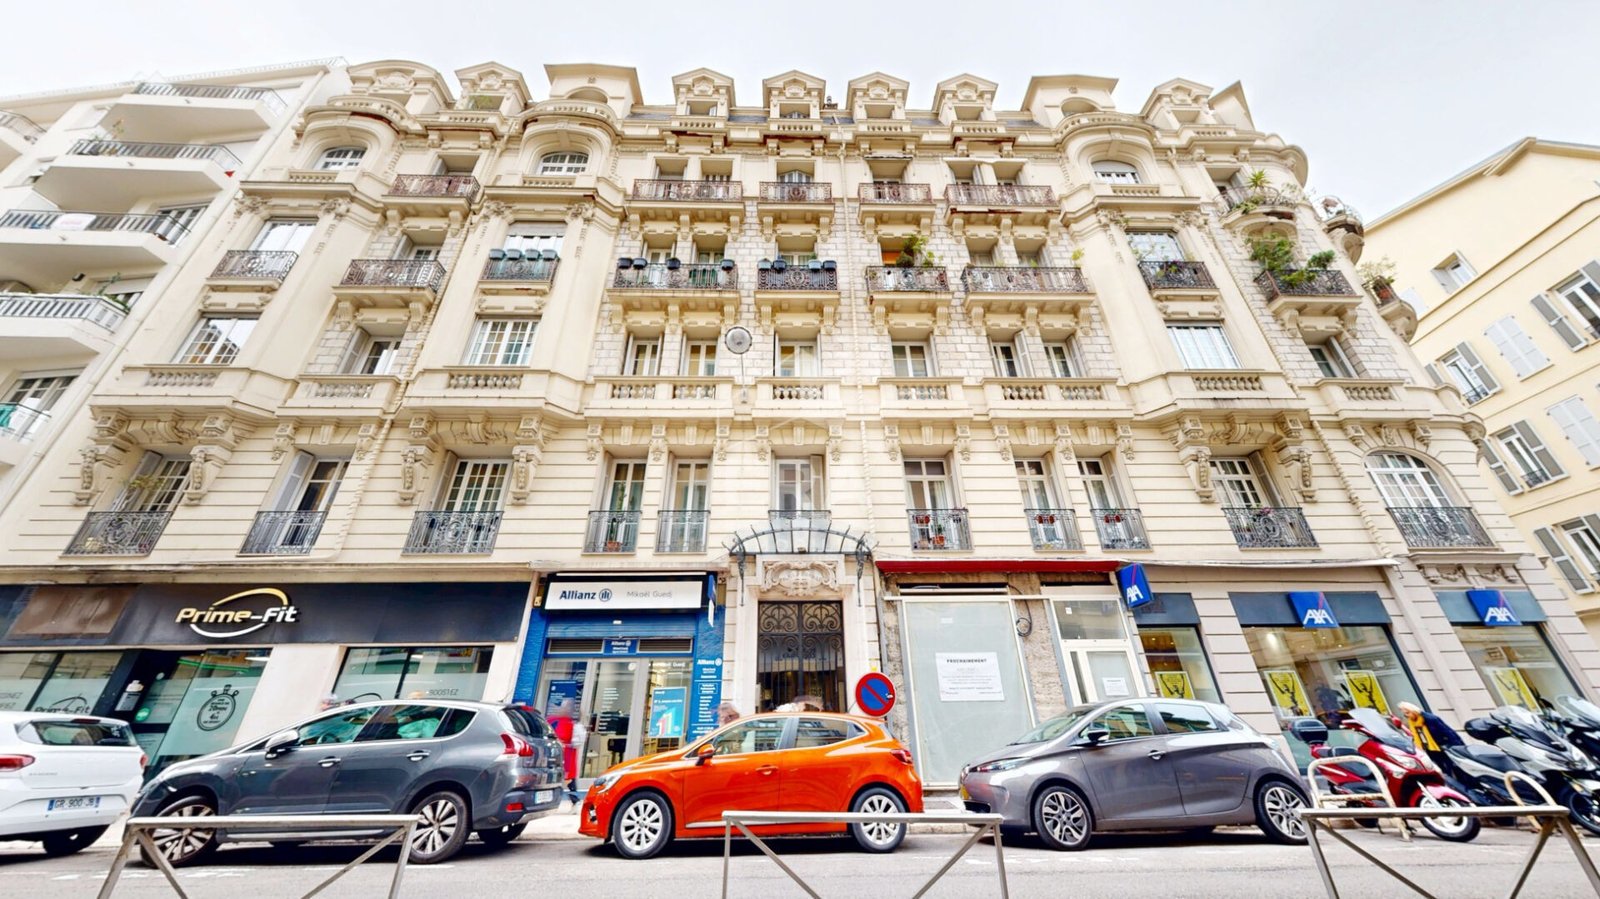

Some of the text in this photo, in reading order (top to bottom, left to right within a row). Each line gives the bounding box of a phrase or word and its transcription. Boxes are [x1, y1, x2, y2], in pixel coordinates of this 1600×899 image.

[559, 590, 597, 600] Allianz
[1126, 584, 1144, 604] AXA
[175, 606, 297, 623] Prime-Fit
[1302, 608, 1334, 625] AXA
[1484, 606, 1517, 622] AXA
